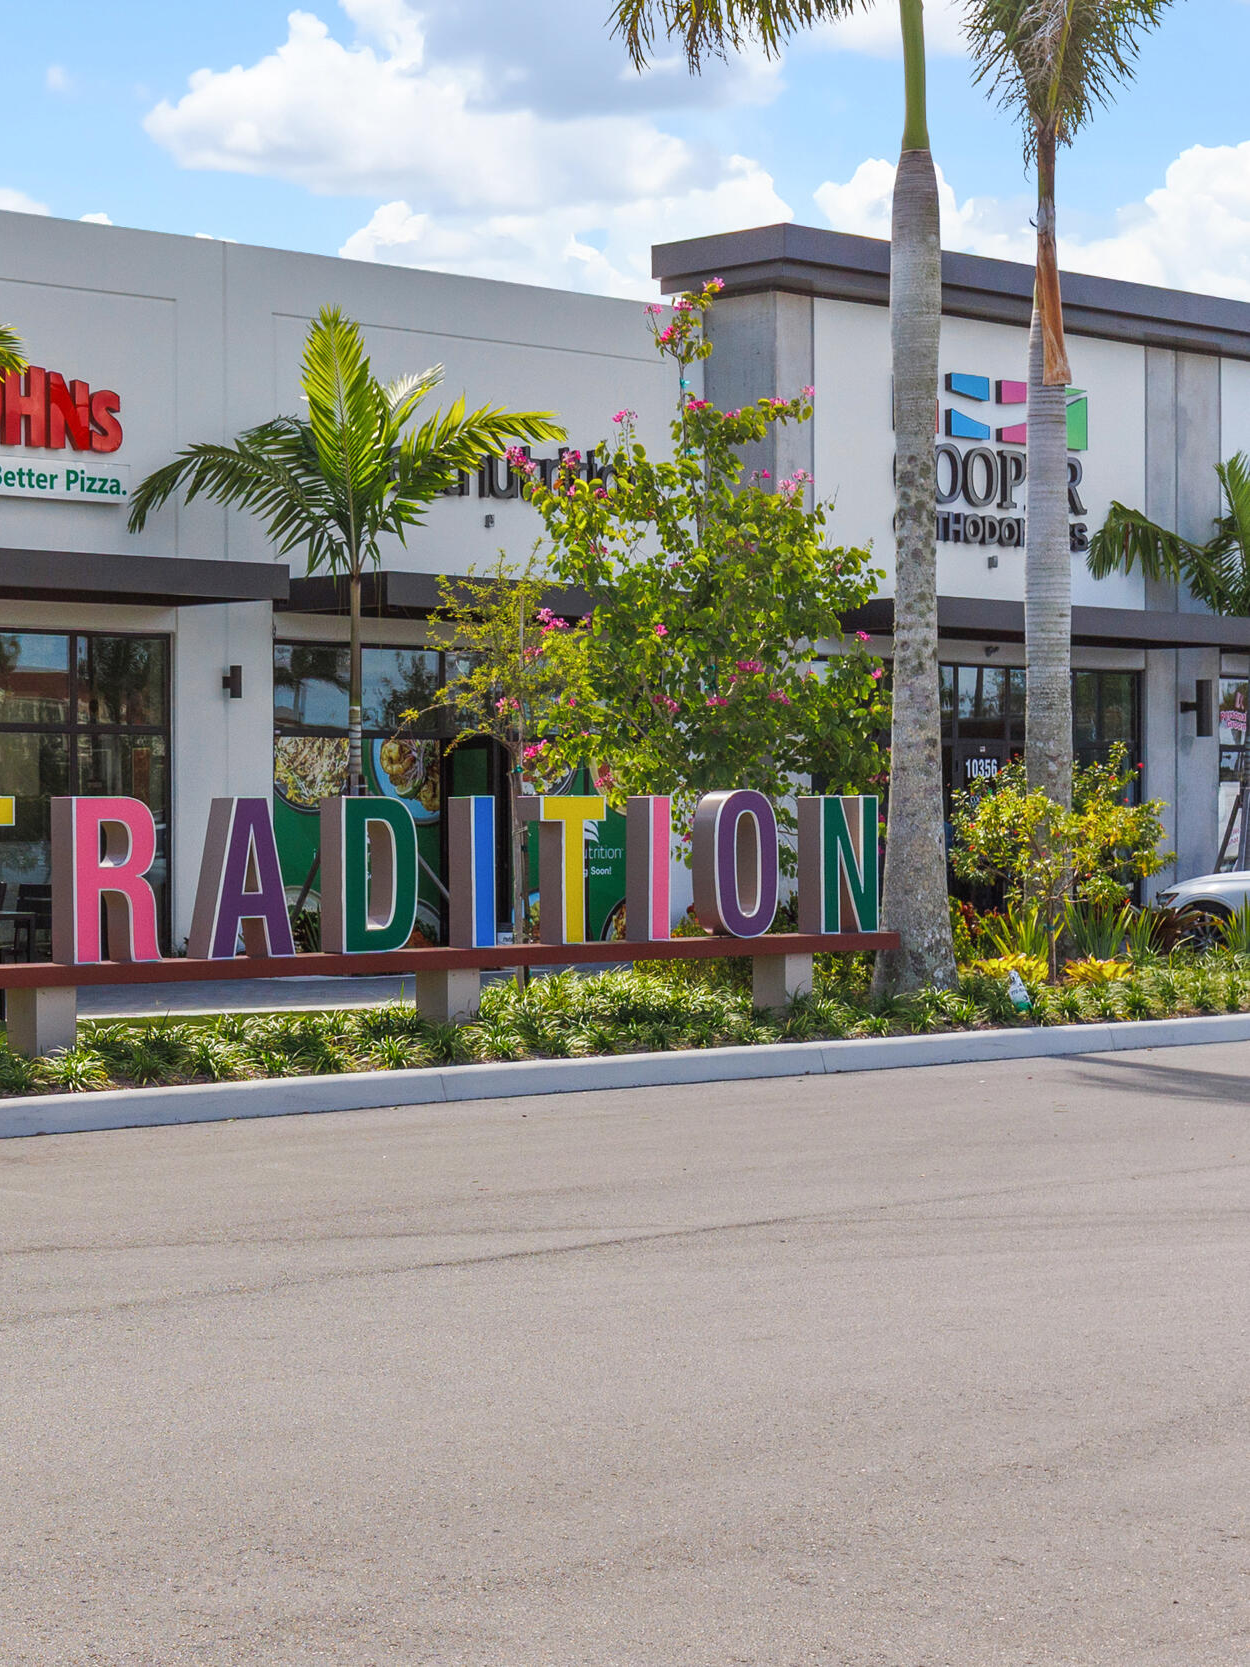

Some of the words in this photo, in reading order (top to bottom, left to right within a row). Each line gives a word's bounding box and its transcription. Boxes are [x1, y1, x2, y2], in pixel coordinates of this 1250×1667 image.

[65, 469, 128, 496] Pizza.
[893, 443, 1088, 516] OOPR
[965, 759, 998, 778] 10356
[590, 866, 613, 876] Soon!
